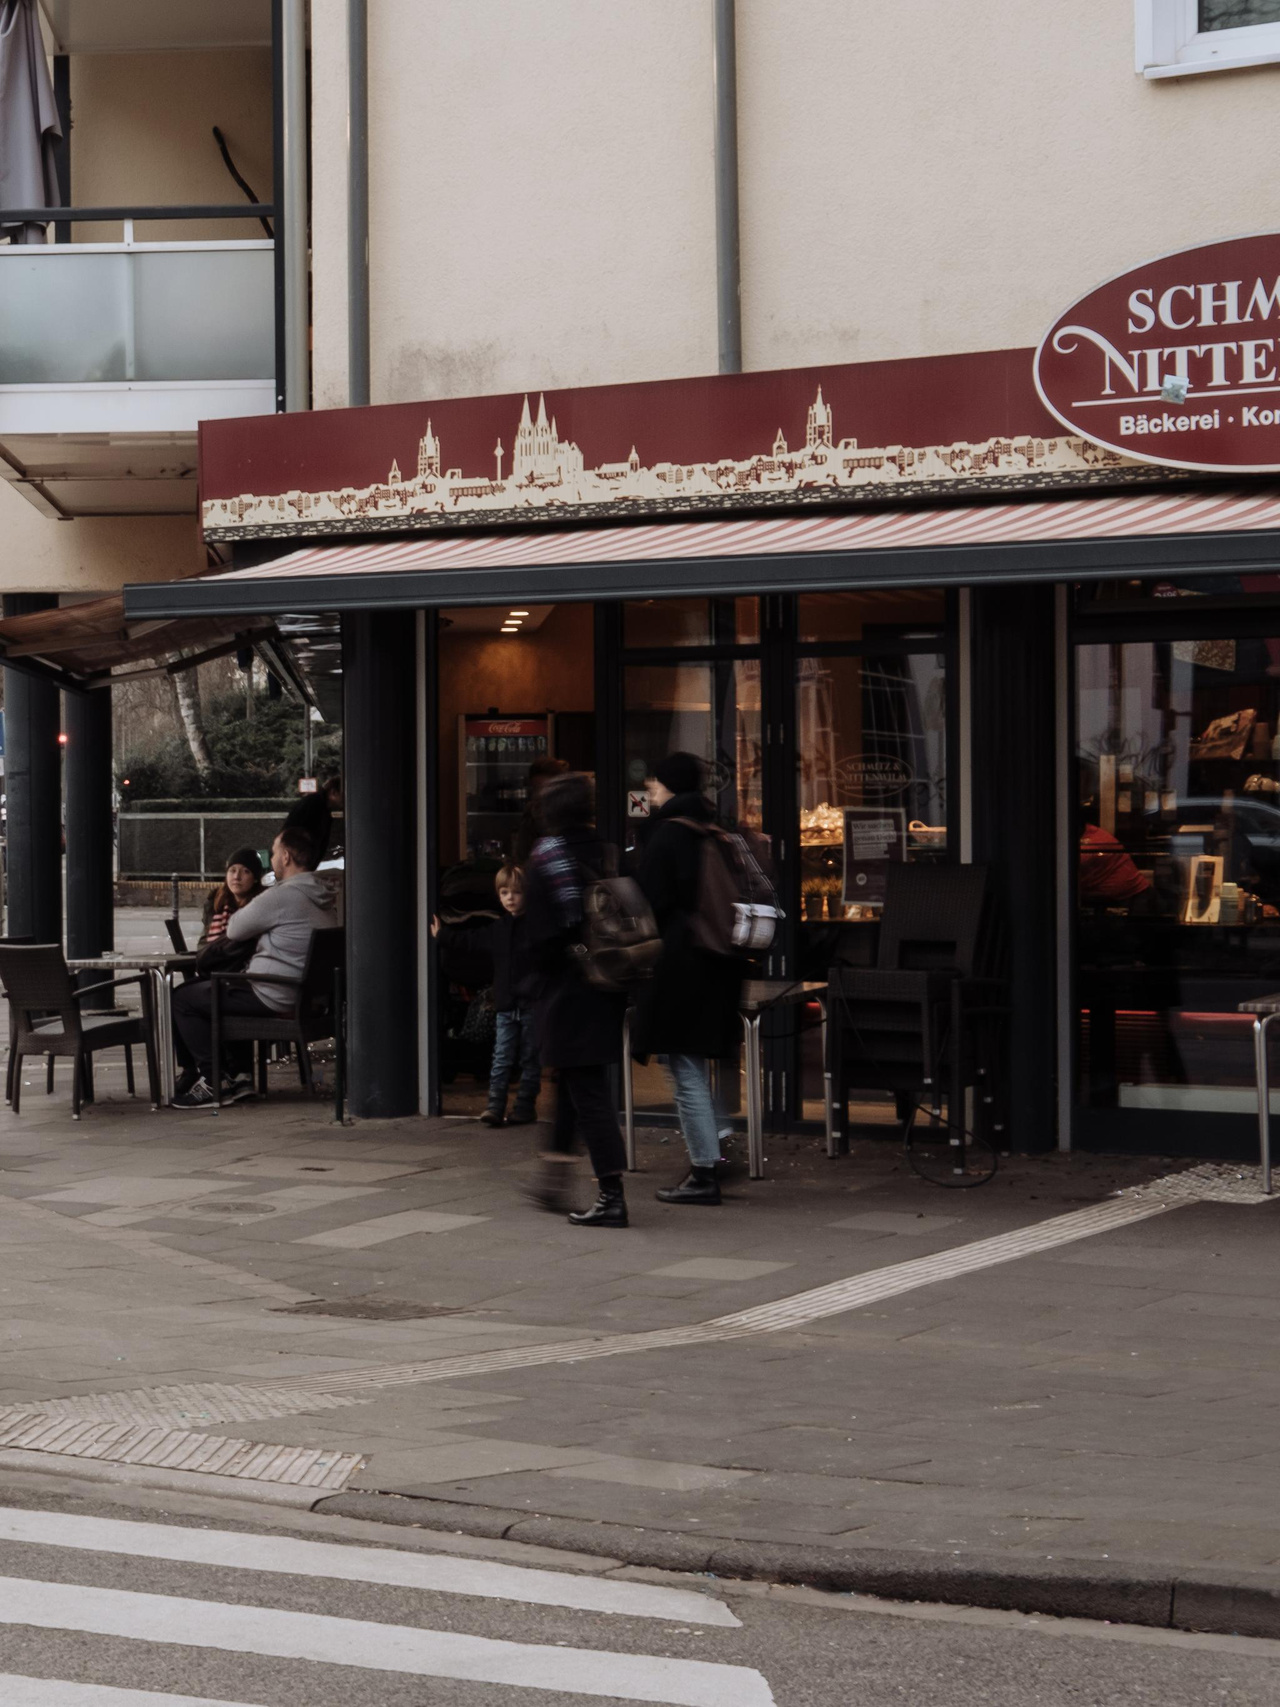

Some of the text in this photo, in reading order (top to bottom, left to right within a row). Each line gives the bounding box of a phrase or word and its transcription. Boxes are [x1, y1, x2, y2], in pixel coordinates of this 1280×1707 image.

[1127, 276, 1280, 334] SCHM
[1052, 325, 1280, 396] NITTE
[1120, 409, 1219, 435] Bäckerei
[488, 722, 521, 733] Coca-Cola
